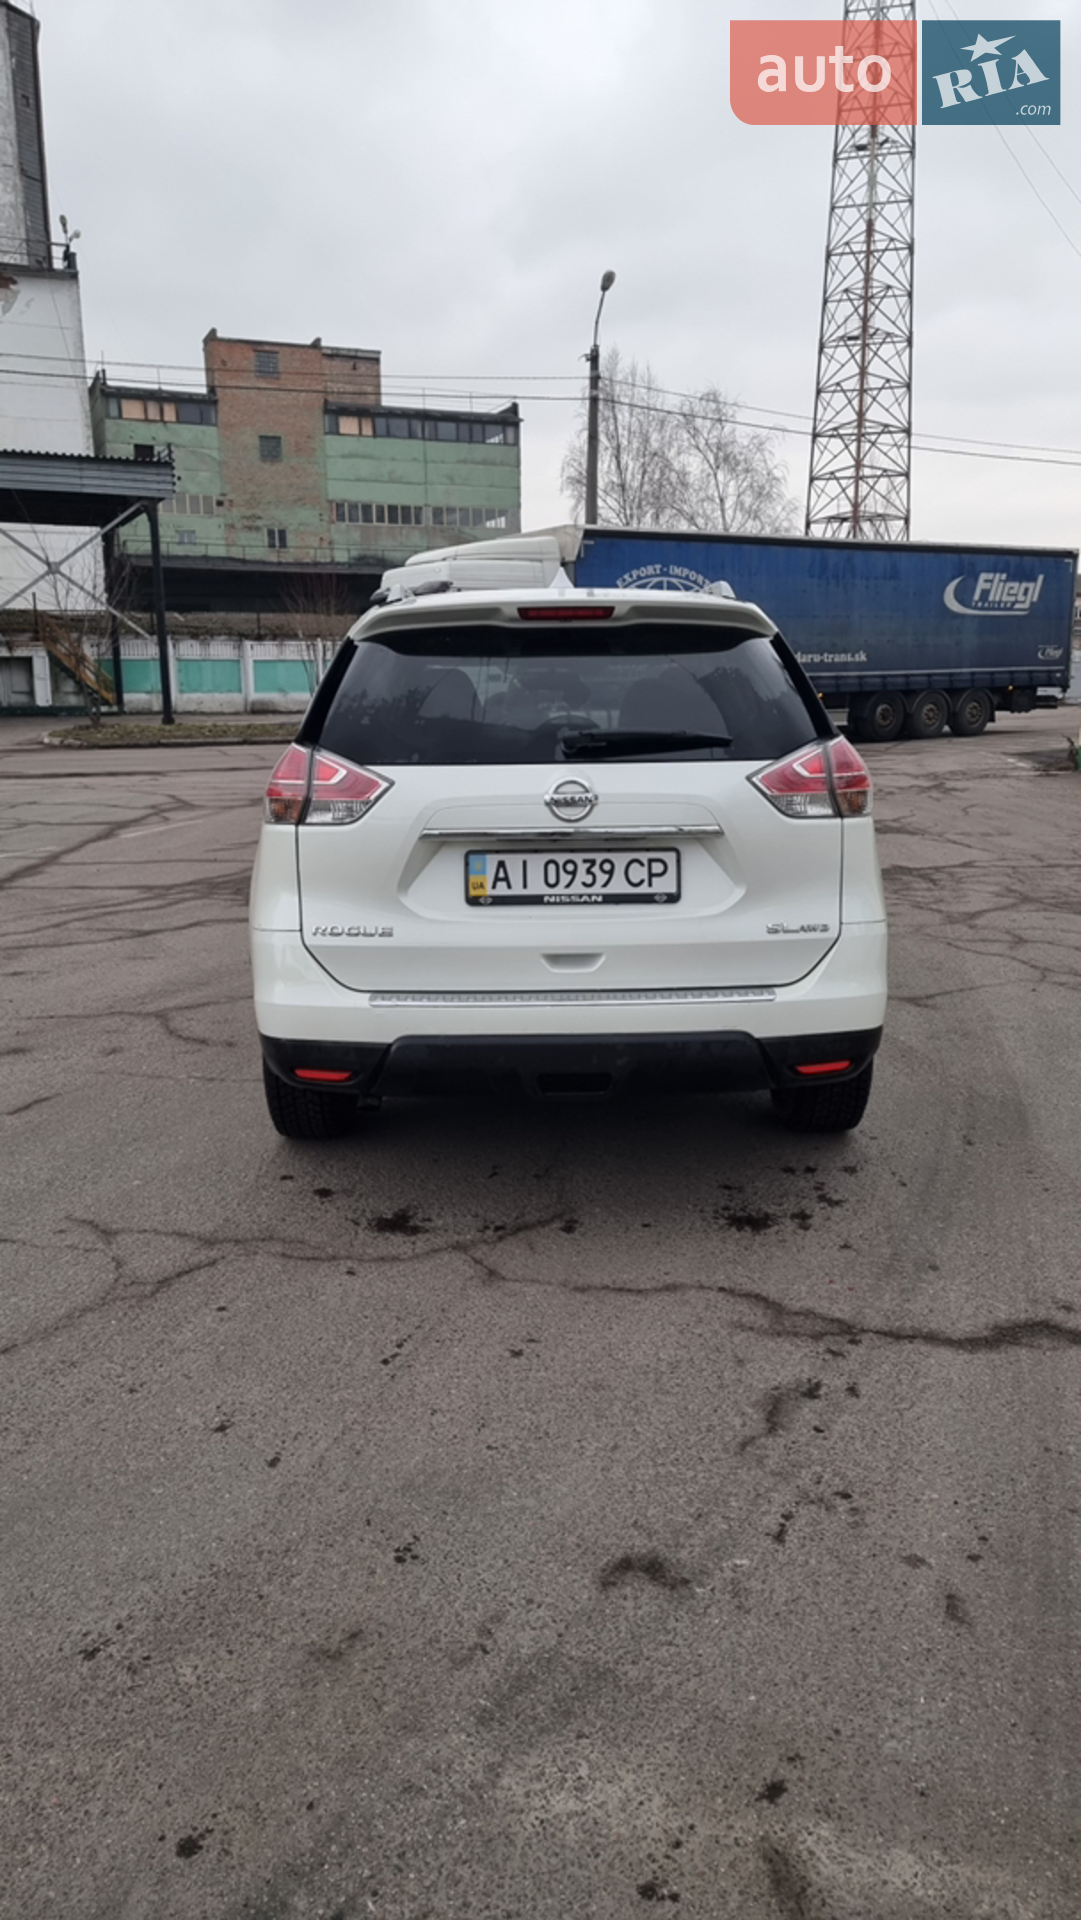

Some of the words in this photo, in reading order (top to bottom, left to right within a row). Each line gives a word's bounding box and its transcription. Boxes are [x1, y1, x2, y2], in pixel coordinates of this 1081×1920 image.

[615, 564, 662, 589] EXPORT
[669, 564, 712, 588] IMPORT
[972, 571, 1045, 609] Fliegl
[549, 795, 593, 807] NISSAN
[491, 859, 528, 890] AI
[543, 858, 616, 889] 0939
[624, 857, 669, 888] CP
[471, 881, 486, 890] UA
[543, 894, 604, 903] NISSAN
[312, 925, 394, 938] ROGUE
